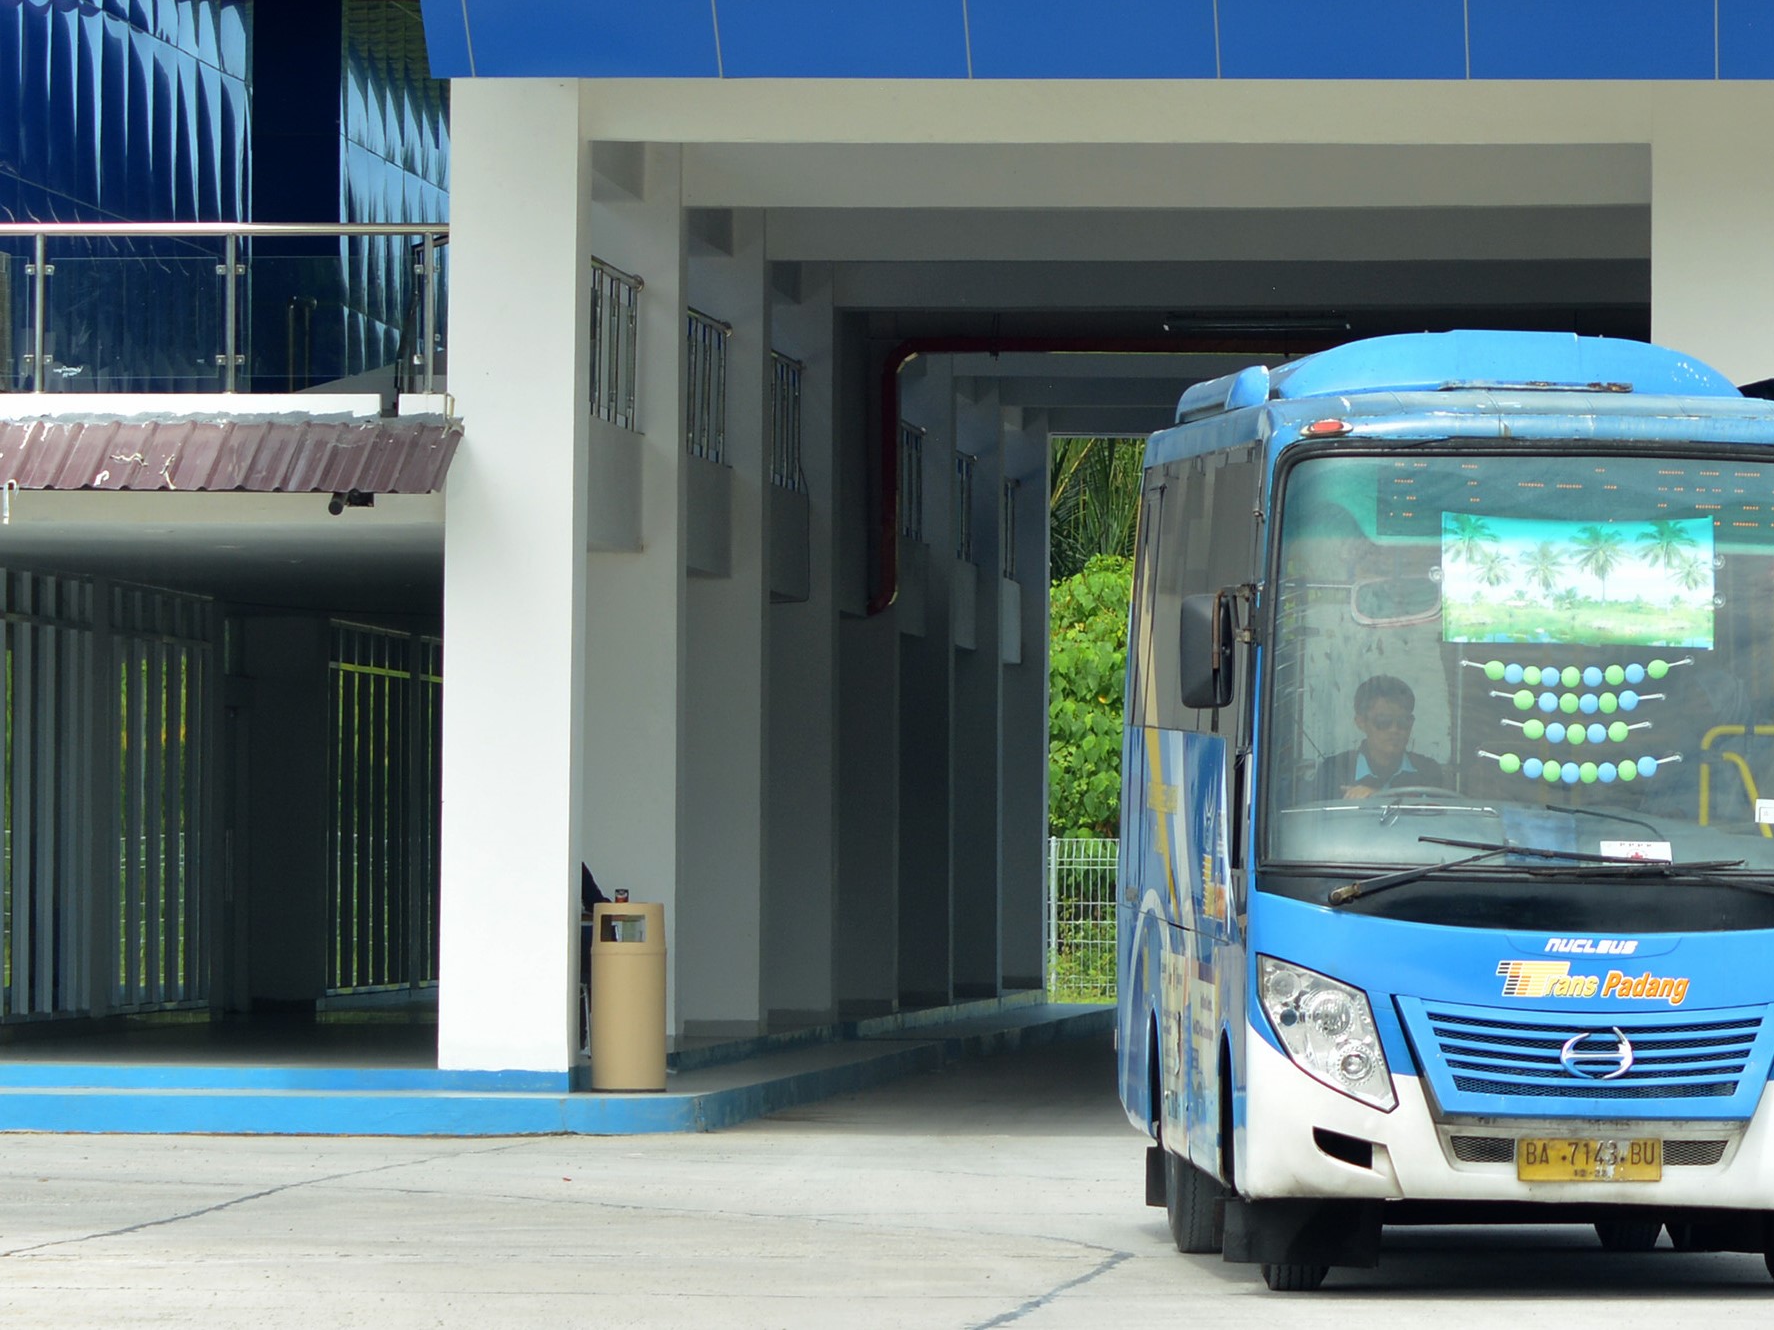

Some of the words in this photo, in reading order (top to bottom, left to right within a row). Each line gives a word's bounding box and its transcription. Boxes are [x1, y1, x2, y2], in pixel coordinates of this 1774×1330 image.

[1544, 938, 1639, 955] NUCLEUS
[1496, 961, 1600, 998] Trans
[1600, 970, 1691, 1006] Padang
[1526, 1141, 1550, 1165] BA
[1567, 1140, 1618, 1166] 7143
[1630, 1142, 1656, 1166] BU
